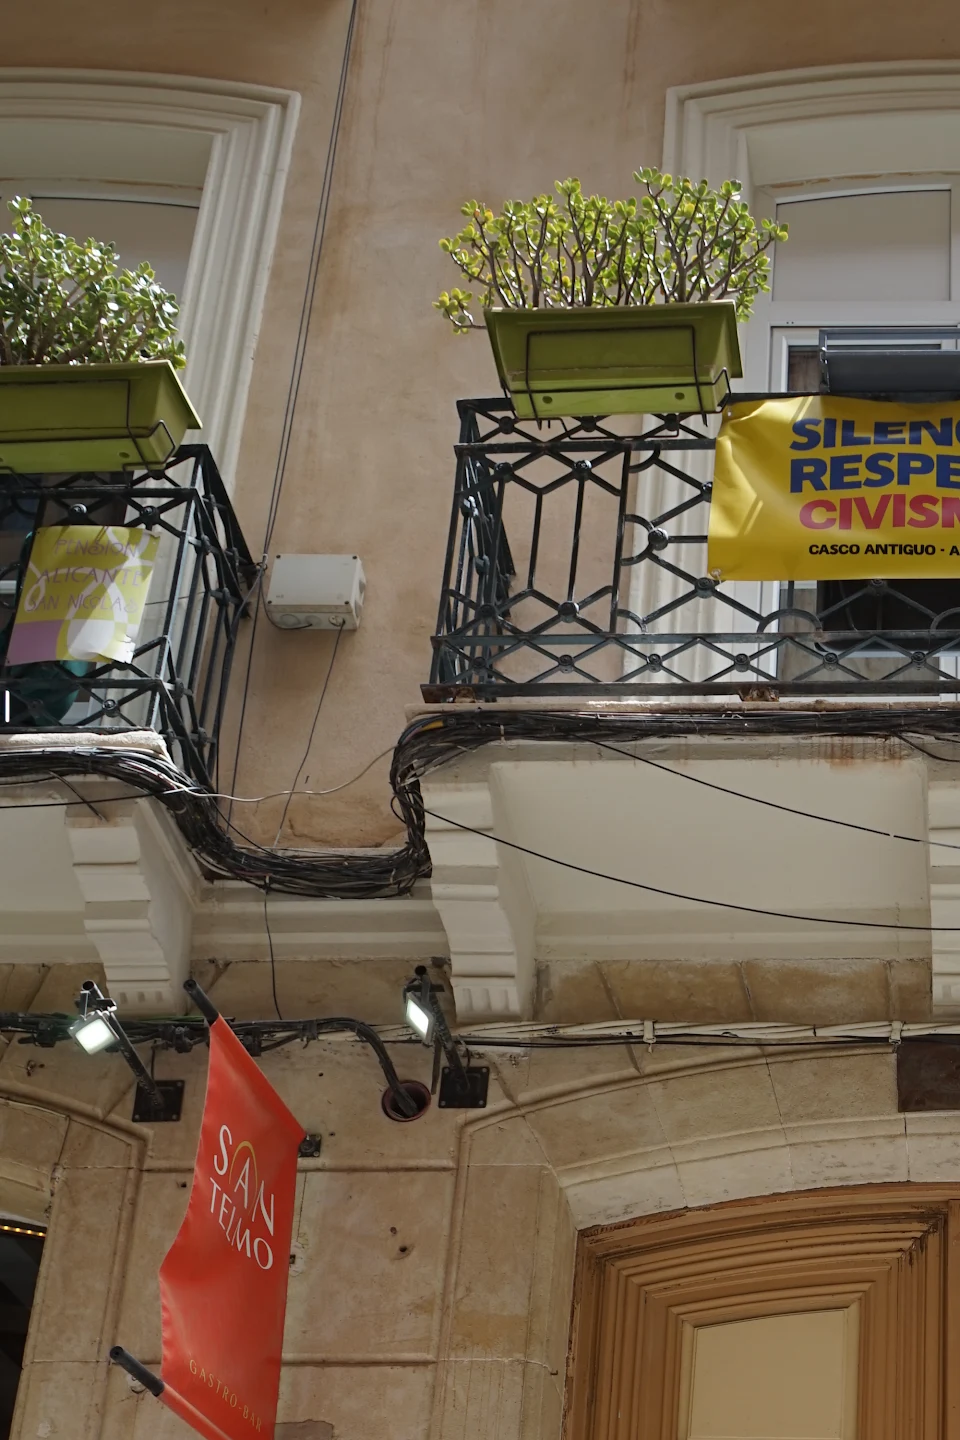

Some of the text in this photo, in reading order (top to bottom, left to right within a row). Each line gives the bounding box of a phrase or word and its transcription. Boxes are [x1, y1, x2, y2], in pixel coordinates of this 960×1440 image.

[55, 539, 139, 558] PENSION
[808, 543, 860, 556] CASCO
[864, 543, 936, 556] ANTIGUO
[37, 566, 146, 587] ALICANTE
[67, 594, 139, 613] NICOLAS
[213, 1124, 274, 1236] SAN
[209, 1176, 274, 1270] TELMO
[189, 1359, 262, 1432] GASTRO-BAR
